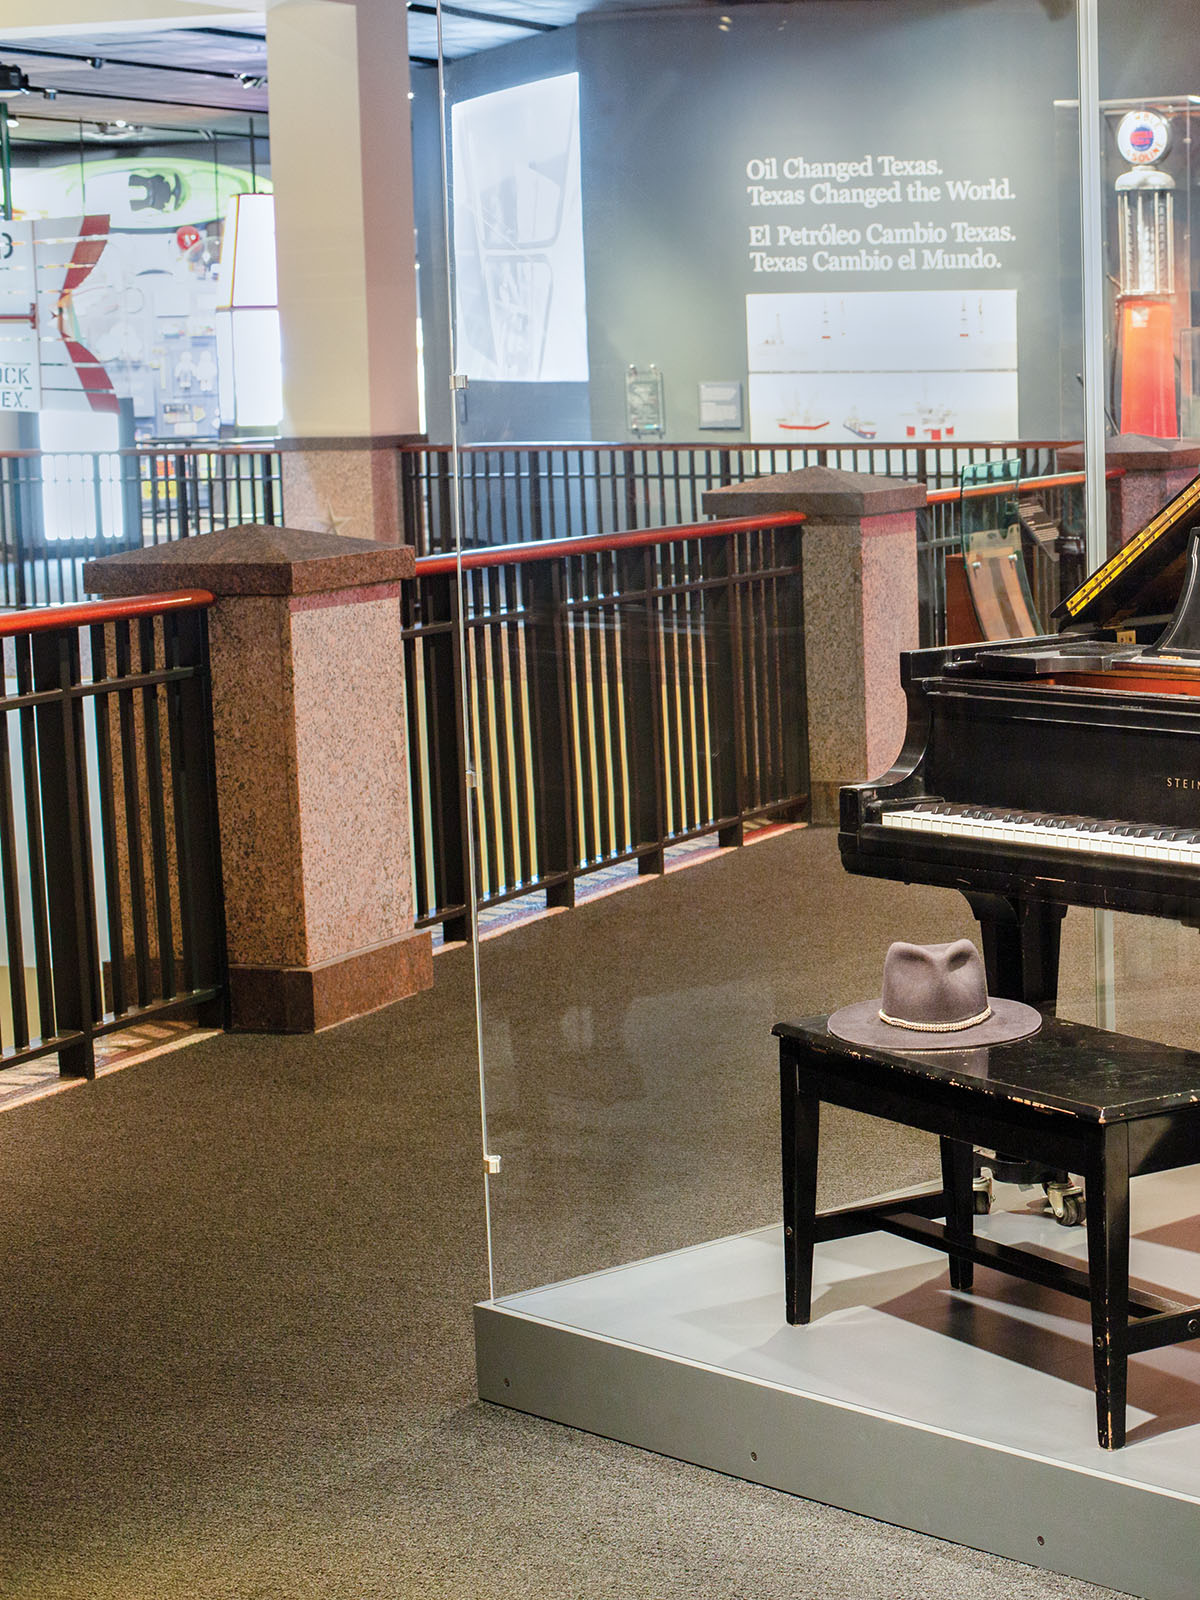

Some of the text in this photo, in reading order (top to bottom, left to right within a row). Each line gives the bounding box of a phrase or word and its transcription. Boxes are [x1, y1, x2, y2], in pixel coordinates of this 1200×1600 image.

[746, 155, 944, 183] Oil Changed Texas.
[747, 178, 1017, 208] Texas Changed the World.
[748, 221, 1017, 247] El Petróleo Cambio Texas.
[749, 247, 1003, 272] Texas Cambio el Mundo.
[0, 367, 30, 385] CK
